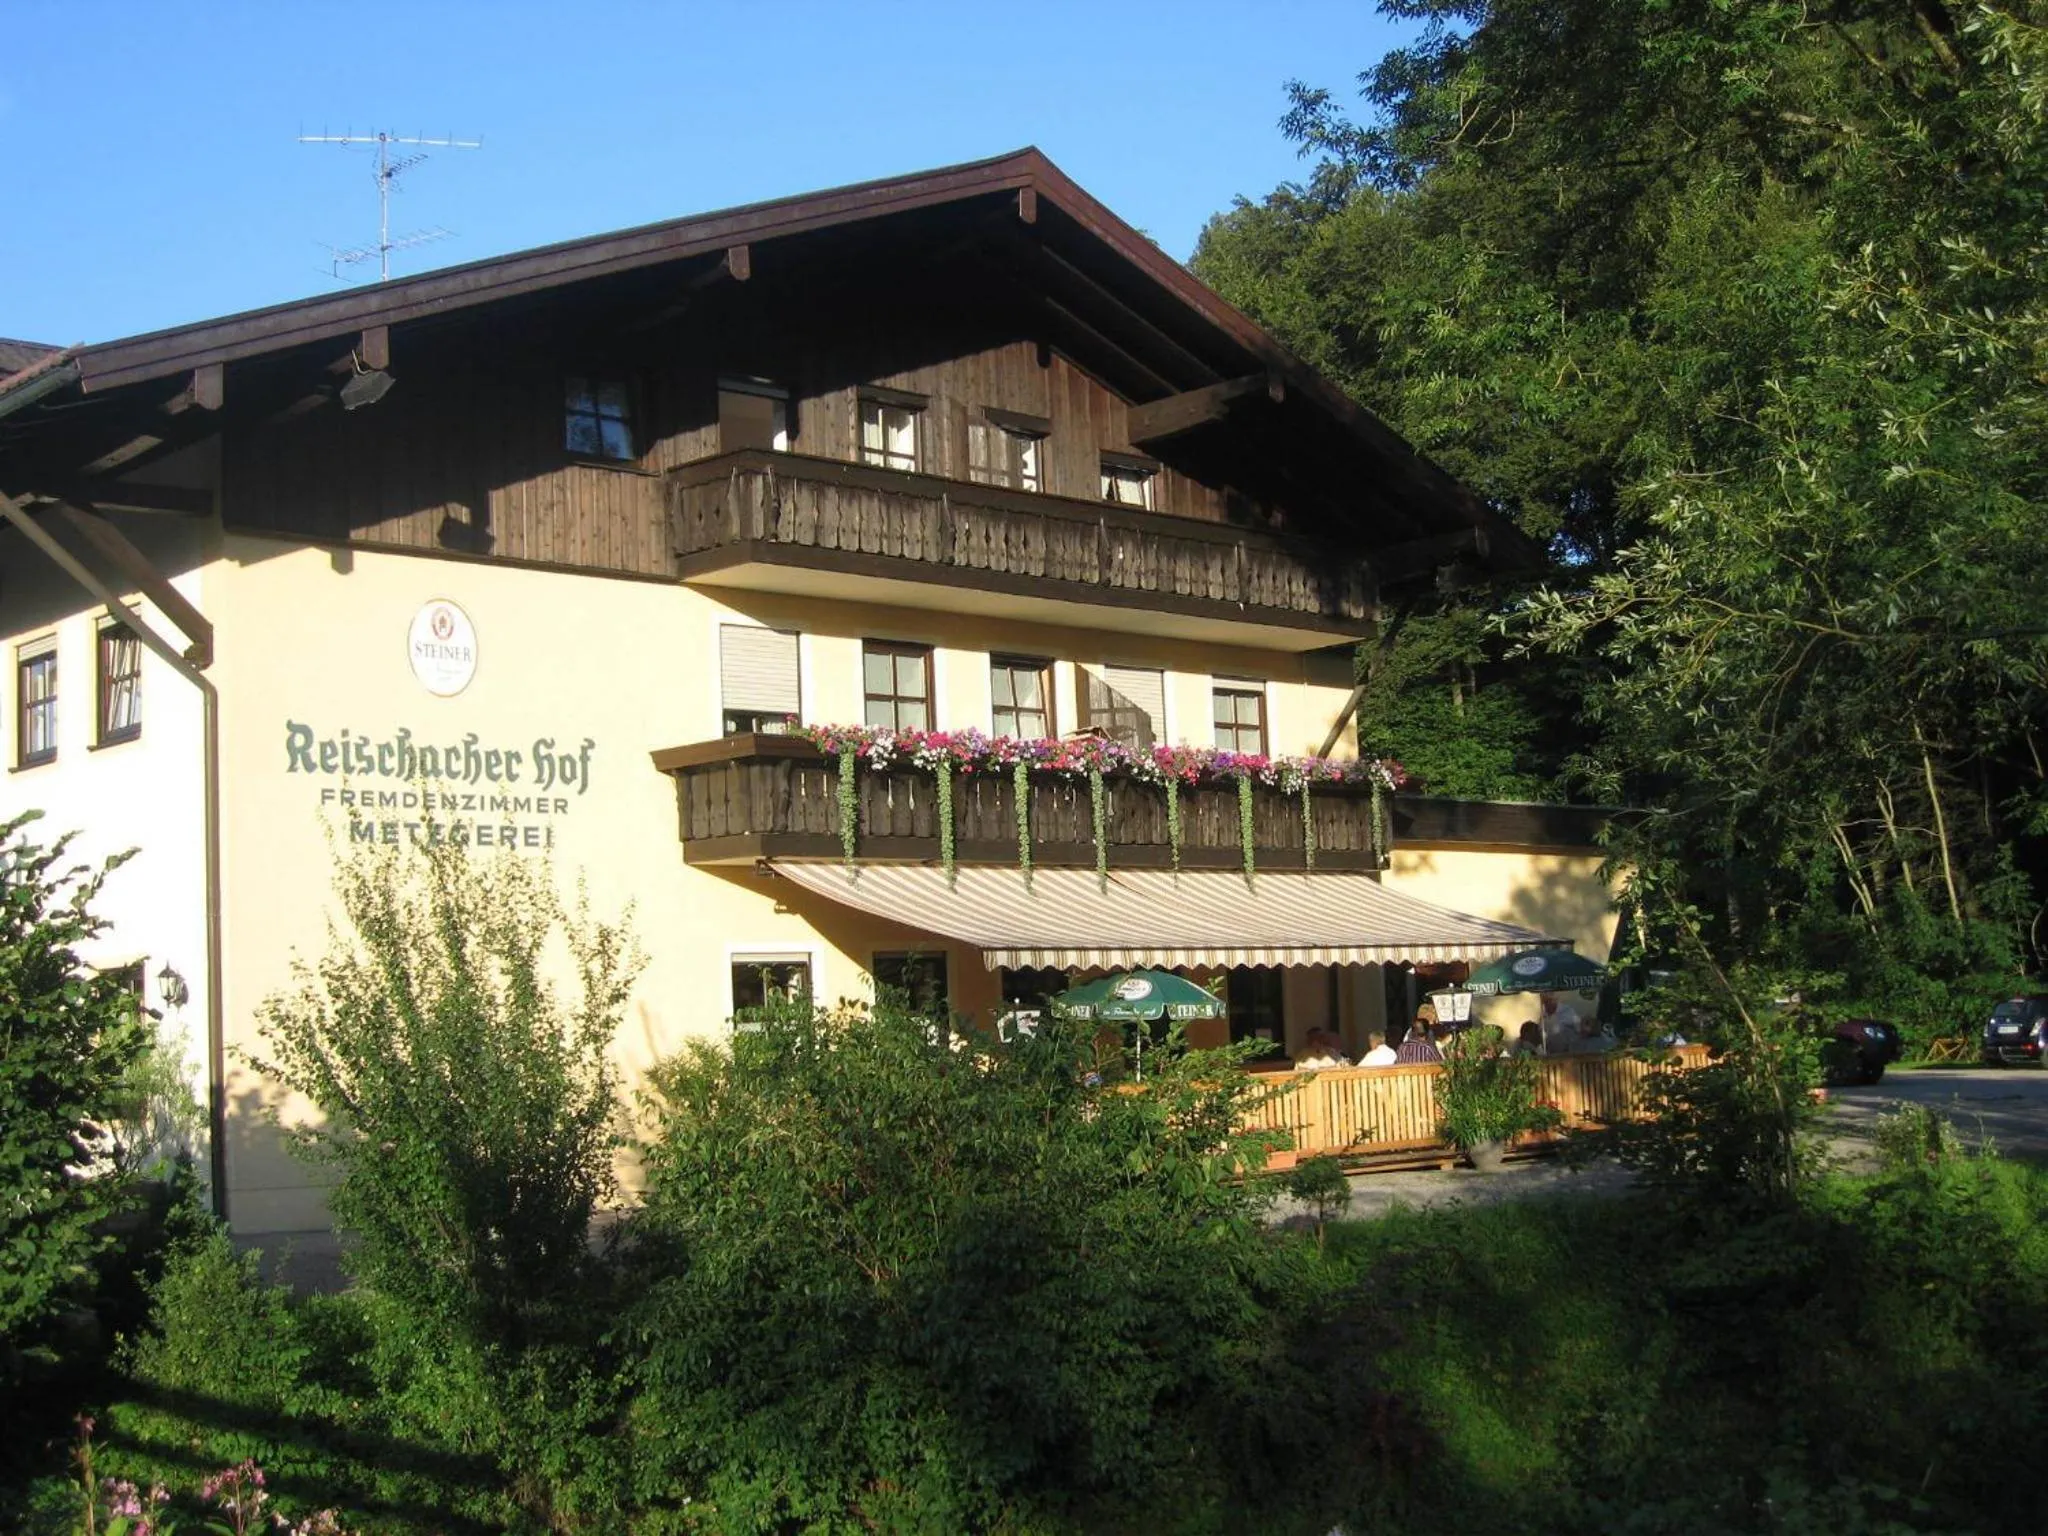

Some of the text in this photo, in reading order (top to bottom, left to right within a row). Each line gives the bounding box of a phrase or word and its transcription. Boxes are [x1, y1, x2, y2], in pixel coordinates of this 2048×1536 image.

[414, 641, 473, 662] STEINER
[285, 719, 596, 796] Reischacher Hof
[320, 788, 570, 815] FREMDENZIMMER
